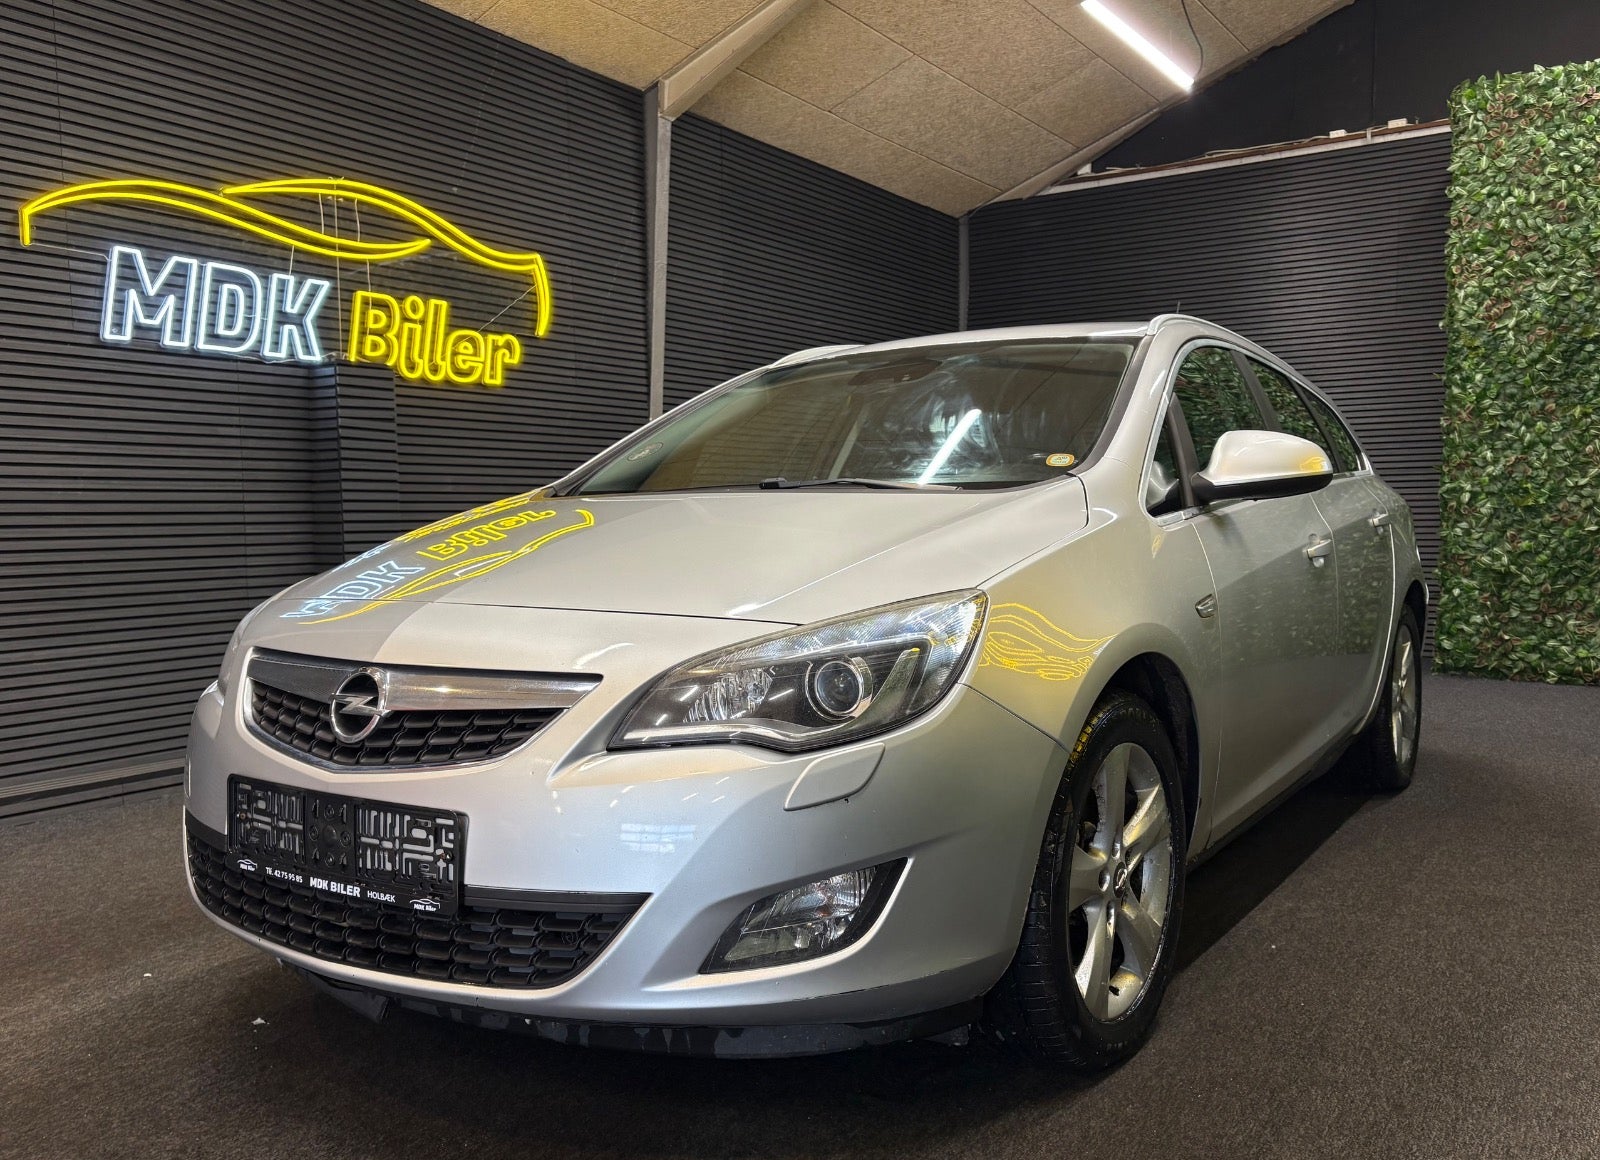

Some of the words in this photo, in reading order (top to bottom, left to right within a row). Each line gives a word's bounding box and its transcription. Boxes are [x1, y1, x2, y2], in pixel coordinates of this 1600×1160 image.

[102, 245, 330, 362] MDK
[349, 289, 521, 386] Biler
[274, 869, 281, 878] 42
[281, 871, 288, 879] 75
[309, 876, 329, 891] MDK
[330, 881, 361, 898] BILER
[367, 890, 396, 903] HOLBÆK
